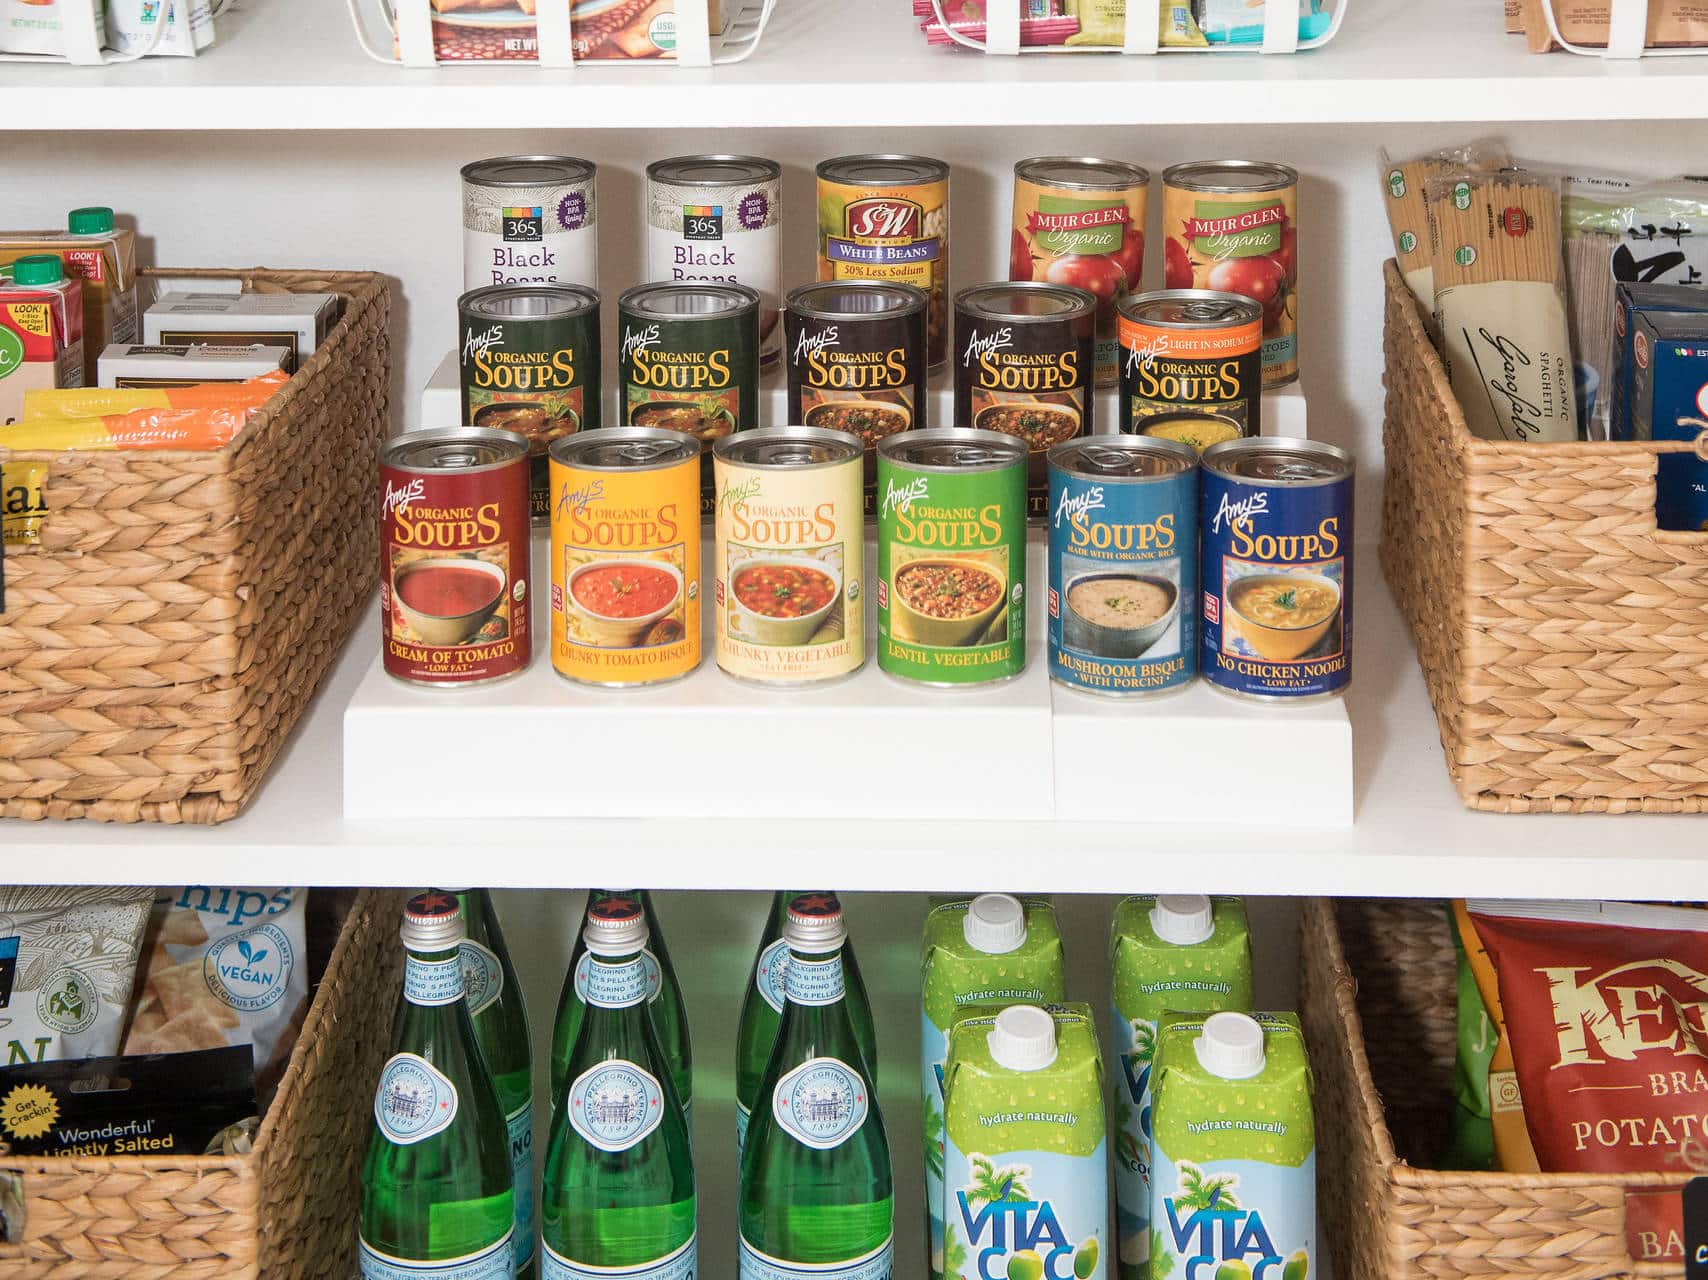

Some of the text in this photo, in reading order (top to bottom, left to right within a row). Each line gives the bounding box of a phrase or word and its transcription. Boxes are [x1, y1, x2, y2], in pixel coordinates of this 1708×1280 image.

[508, 219, 537, 236] 365
[688, 217, 717, 235] 365
[1037, 214, 1077, 229] MUIR
[1195, 218, 1238, 234] MUIR
[840, 244, 928, 260] WHITE BEANS
[1047, 226, 1114, 256] Organic
[1207, 232, 1272, 261] Organic
[493, 247, 555, 267] Black
[674, 246, 735, 265] Black
[845, 265, 924, 277] 50% Less Sodium
[15, 304, 41, 313] LOOK!
[463, 325, 504, 365] Amy's
[622, 325, 660, 363] Amy's
[793, 327, 840, 366] Amy's
[964, 328, 1012, 368] Amy's
[1170, 338, 1244, 349] LIGHT IN SODIUM
[475, 349, 574, 388] SOUPS
[495, 352, 548, 363] ORGANIC
[633, 350, 730, 388] SOUPS
[652, 352, 704, 363] ORGANIC
[809, 349, 907, 388] SOUPS
[830, 352, 882, 364] ORGANIC
[1002, 354, 1055, 366] ORGANIC
[1126, 336, 1169, 378] Amy's
[980, 350, 1077, 389] SOUPS
[1139, 361, 1240, 400] SOUPS
[1162, 364, 1216, 375] ORGANIC
[1539, 351, 1553, 419] SPAGHETTI
[1555, 356, 1569, 422] ORGANIC
[383, 479, 426, 520] Amy's
[557, 480, 607, 521] Amy's
[719, 477, 762, 516] Amy's
[882, 477, 929, 520] Amy's
[1055, 486, 1105, 528] Amy's
[416, 504, 473, 519] ORGANIC
[595, 506, 651, 520] ORGANIC
[732, 503, 836, 544] SOUPS
[753, 506, 809, 519] ORGANIC
[918, 506, 976, 519] ORGANIC
[1212, 492, 1269, 534] Amy's
[395, 503, 500, 546] SOUPS
[572, 504, 678, 546] SOUPS
[896, 504, 1002, 546] SOUPS
[1071, 513, 1175, 550] SOUPS
[1231, 517, 1338, 560] SOUPS
[1116, 550, 1155, 561] ORGANIC
[389, 641, 514, 664] CREAM OF TOMATO
[561, 643, 601, 665] CHUNKY
[604, 652, 657, 666] TOMATO
[775, 642, 851, 663] VEGETABLE
[888, 640, 1010, 666] LENTIL VEGETABLE
[1057, 651, 1185, 678] MUSHROOM BISQUE
[1216, 652, 1347, 679] NO CHICKEN NOODLE
[1080, 673, 1164, 688] WITH PORCINI
[1266, 679, 1287, 687] LOW
[221, 965, 273, 986] VEGAN
[1141, 980, 1232, 995] hydrate naturally
[208, 974, 282, 1008] DELICIOUS FLAVOR
[954, 989, 1045, 1004] hydrate naturally
[9, 1102, 52, 1128] Crackin'
[16, 1099, 37, 1114] Get
[979, 1111, 1078, 1127] hydrate naturally
[1187, 1120, 1287, 1136] hydrate naturally
[60, 1121, 151, 1144] Wonderful
[114, 1134, 174, 1152] Salted
[956, 1190, 1071, 1251] VITA
[1164, 1198, 1279, 1261] VITA
